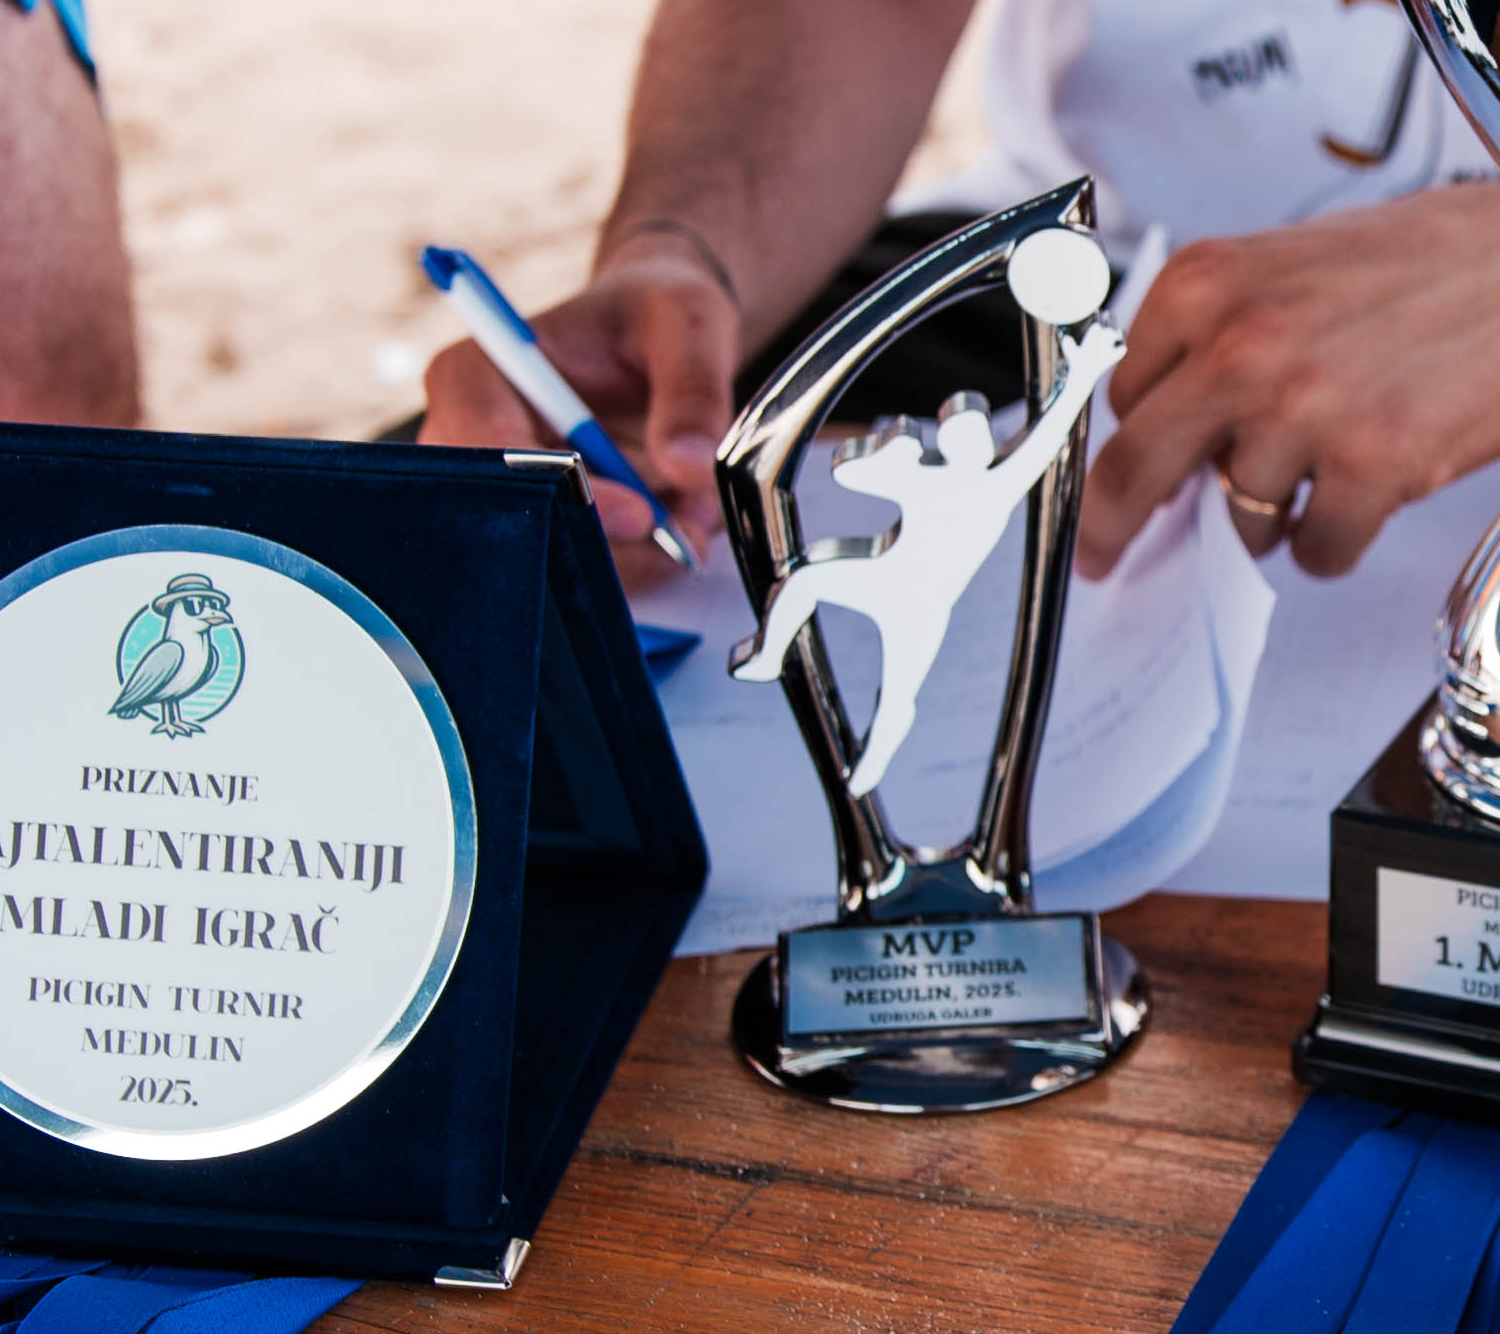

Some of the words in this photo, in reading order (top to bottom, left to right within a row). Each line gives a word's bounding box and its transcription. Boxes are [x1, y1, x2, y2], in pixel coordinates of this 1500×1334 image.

[80, 765, 260, 805] PRIZNANJE
[194, 904, 340, 955] IGRAČ
[881, 929, 976, 959] MVP
[1435, 936, 1463, 969] 1.
[831, 964, 917, 984] PICIGIN
[925, 958, 1027, 976] TURNIRA
[27, 976, 151, 1010] PICIGIN
[169, 987, 304, 1020] TURNIR
[844, 985, 958, 1007] MEDULIN,
[965, 982, 1021, 1000] 2025.
[870, 1011, 936, 1025] UDRUGA
[941, 1007, 992, 1020] GALEB
[79, 1027, 245, 1062] MEDULIN
[119, 1075, 198, 1108] 2025.
